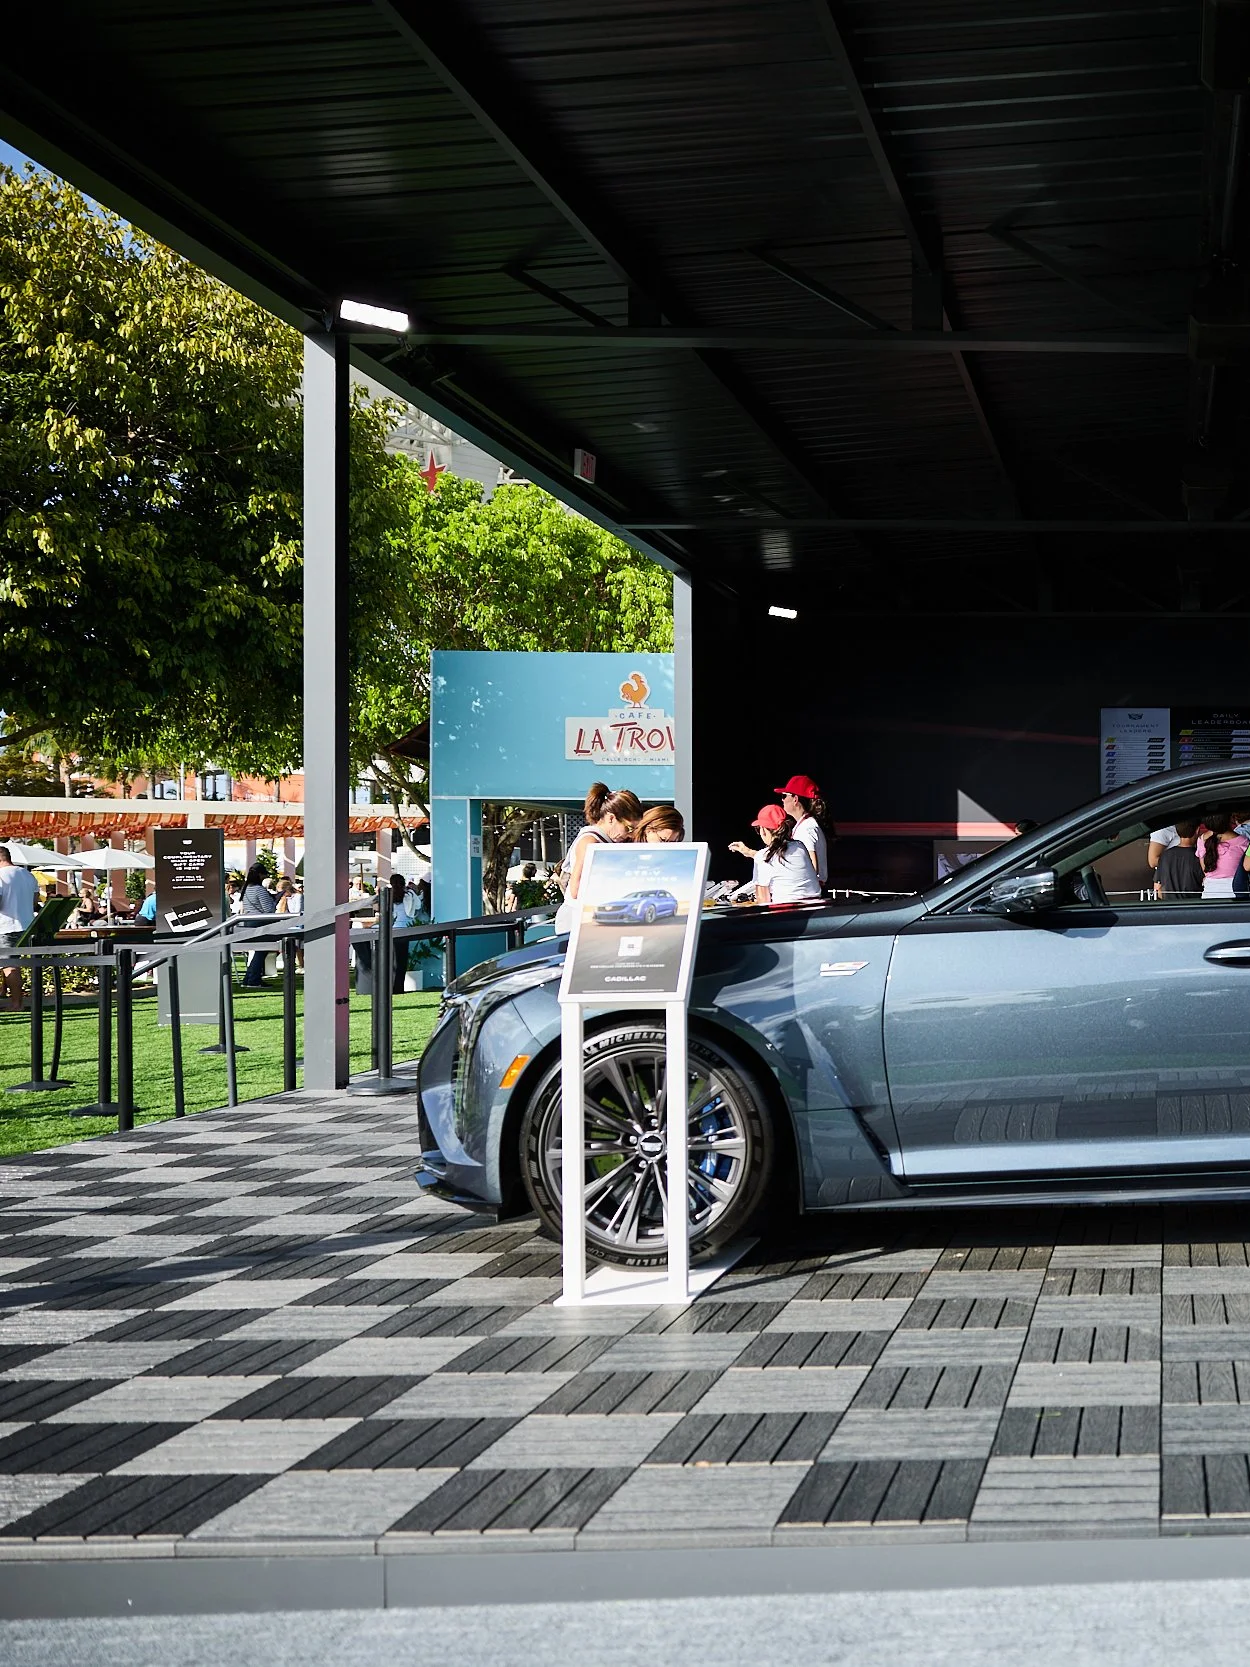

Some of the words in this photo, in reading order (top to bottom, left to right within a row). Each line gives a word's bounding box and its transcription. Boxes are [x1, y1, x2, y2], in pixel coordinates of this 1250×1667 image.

[620, 712, 652, 720] CAFE
[573, 728, 606, 755] LA
[177, 906, 208, 918] CADILLAC
[599, 1032, 665, 1047] MICHELIN
[586, 1247, 605, 1257] CUP
[625, 1257, 667, 1266] HELIN
